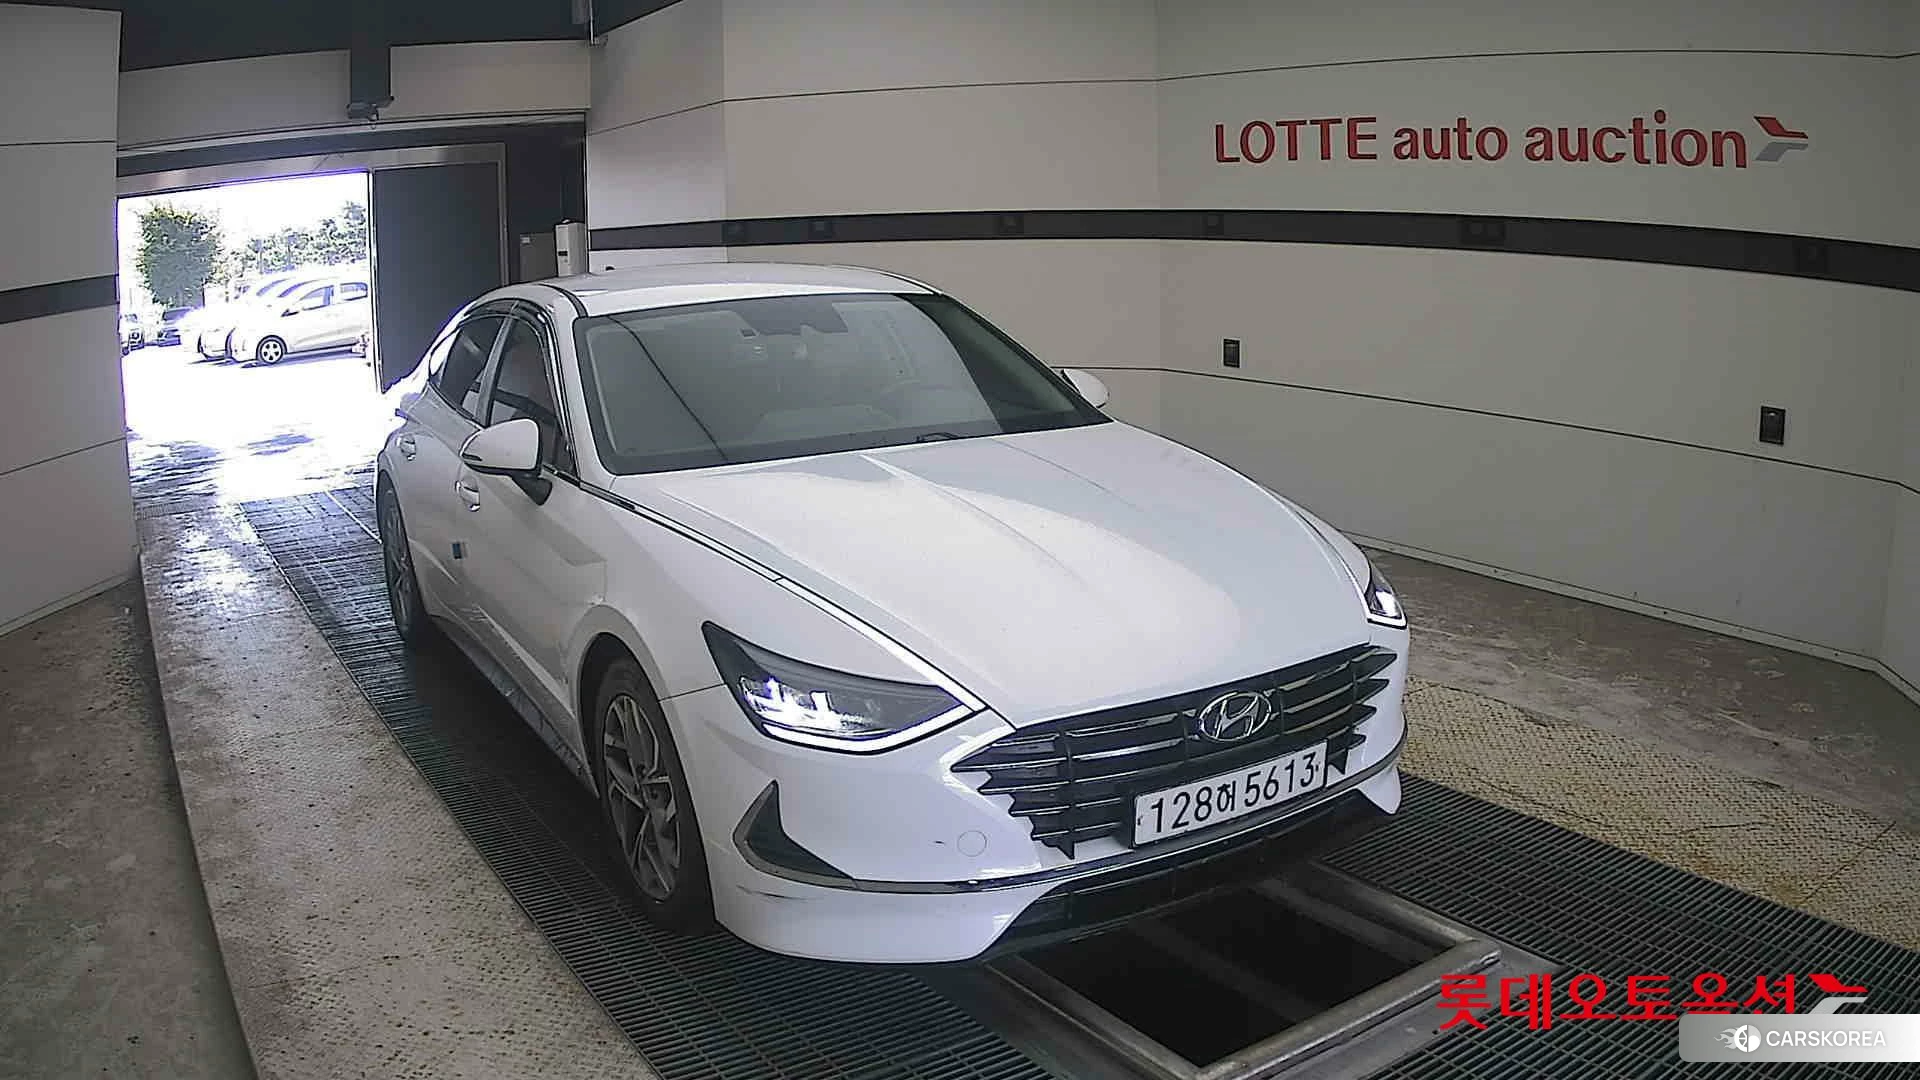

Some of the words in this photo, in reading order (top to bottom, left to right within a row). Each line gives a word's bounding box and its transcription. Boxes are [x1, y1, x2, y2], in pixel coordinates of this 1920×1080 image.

[1215, 116, 1378, 164] LOTTE
[1392, 116, 1510, 163] auto
[1523, 109, 1749, 169] auction
